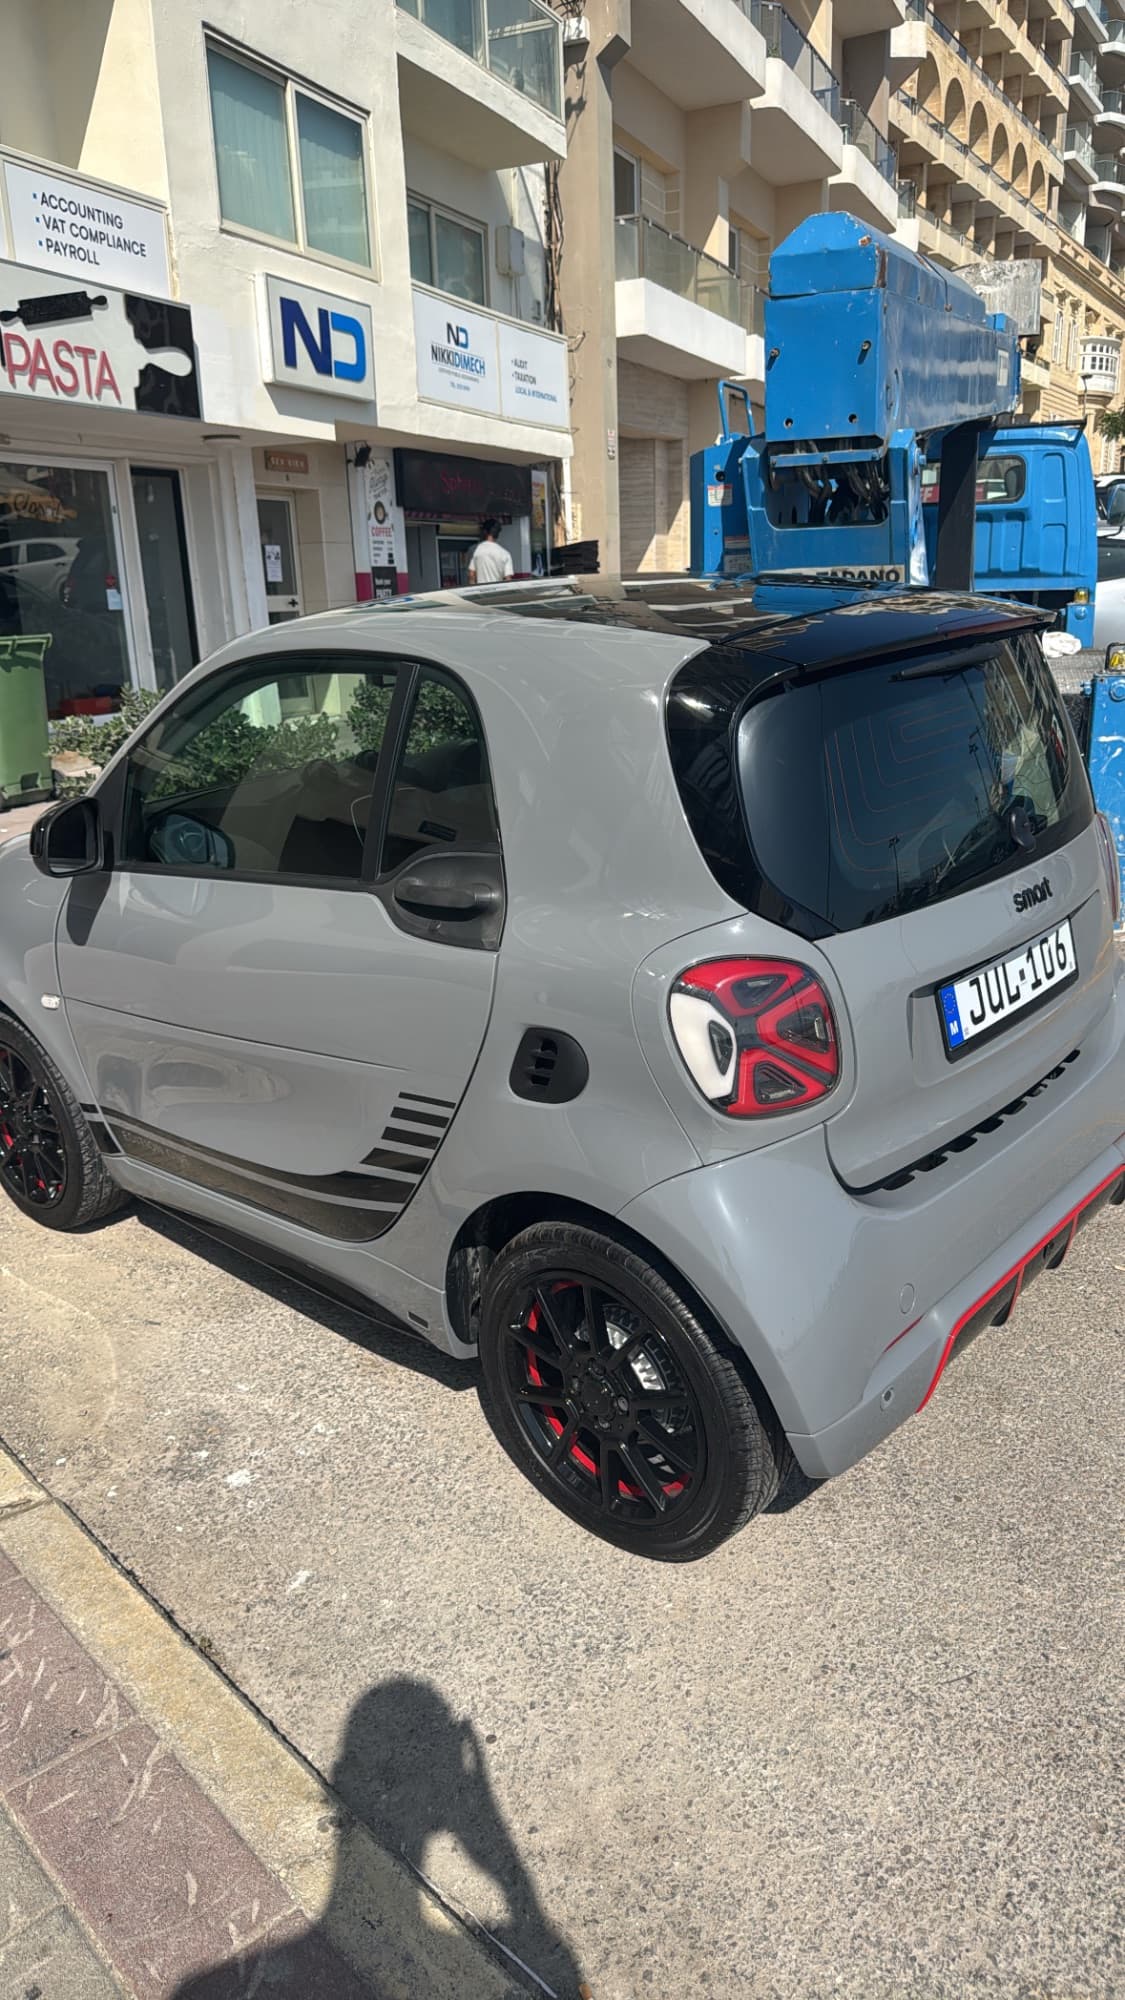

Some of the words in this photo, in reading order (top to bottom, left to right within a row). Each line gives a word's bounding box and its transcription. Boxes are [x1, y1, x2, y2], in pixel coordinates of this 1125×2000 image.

[40, 191, 123, 230] ACCOUNTING
[42, 215, 66, 235] VAT
[70, 222, 147, 258] COMPLIANCE
[46, 238, 100, 266] PAYROLL
[280, 296, 367, 383] ND
[446, 321, 469, 350] ND
[3, 332, 122, 404] PASTA
[431, 344, 486, 377] NIKKIDIMECH
[514, 358, 528, 369] AUDIT
[514, 371, 537, 385] TAXATION
[372, 527, 393, 538] COFFEE
[1013, 876, 1053, 913] smart
[949, 1020, 959, 1036] M
